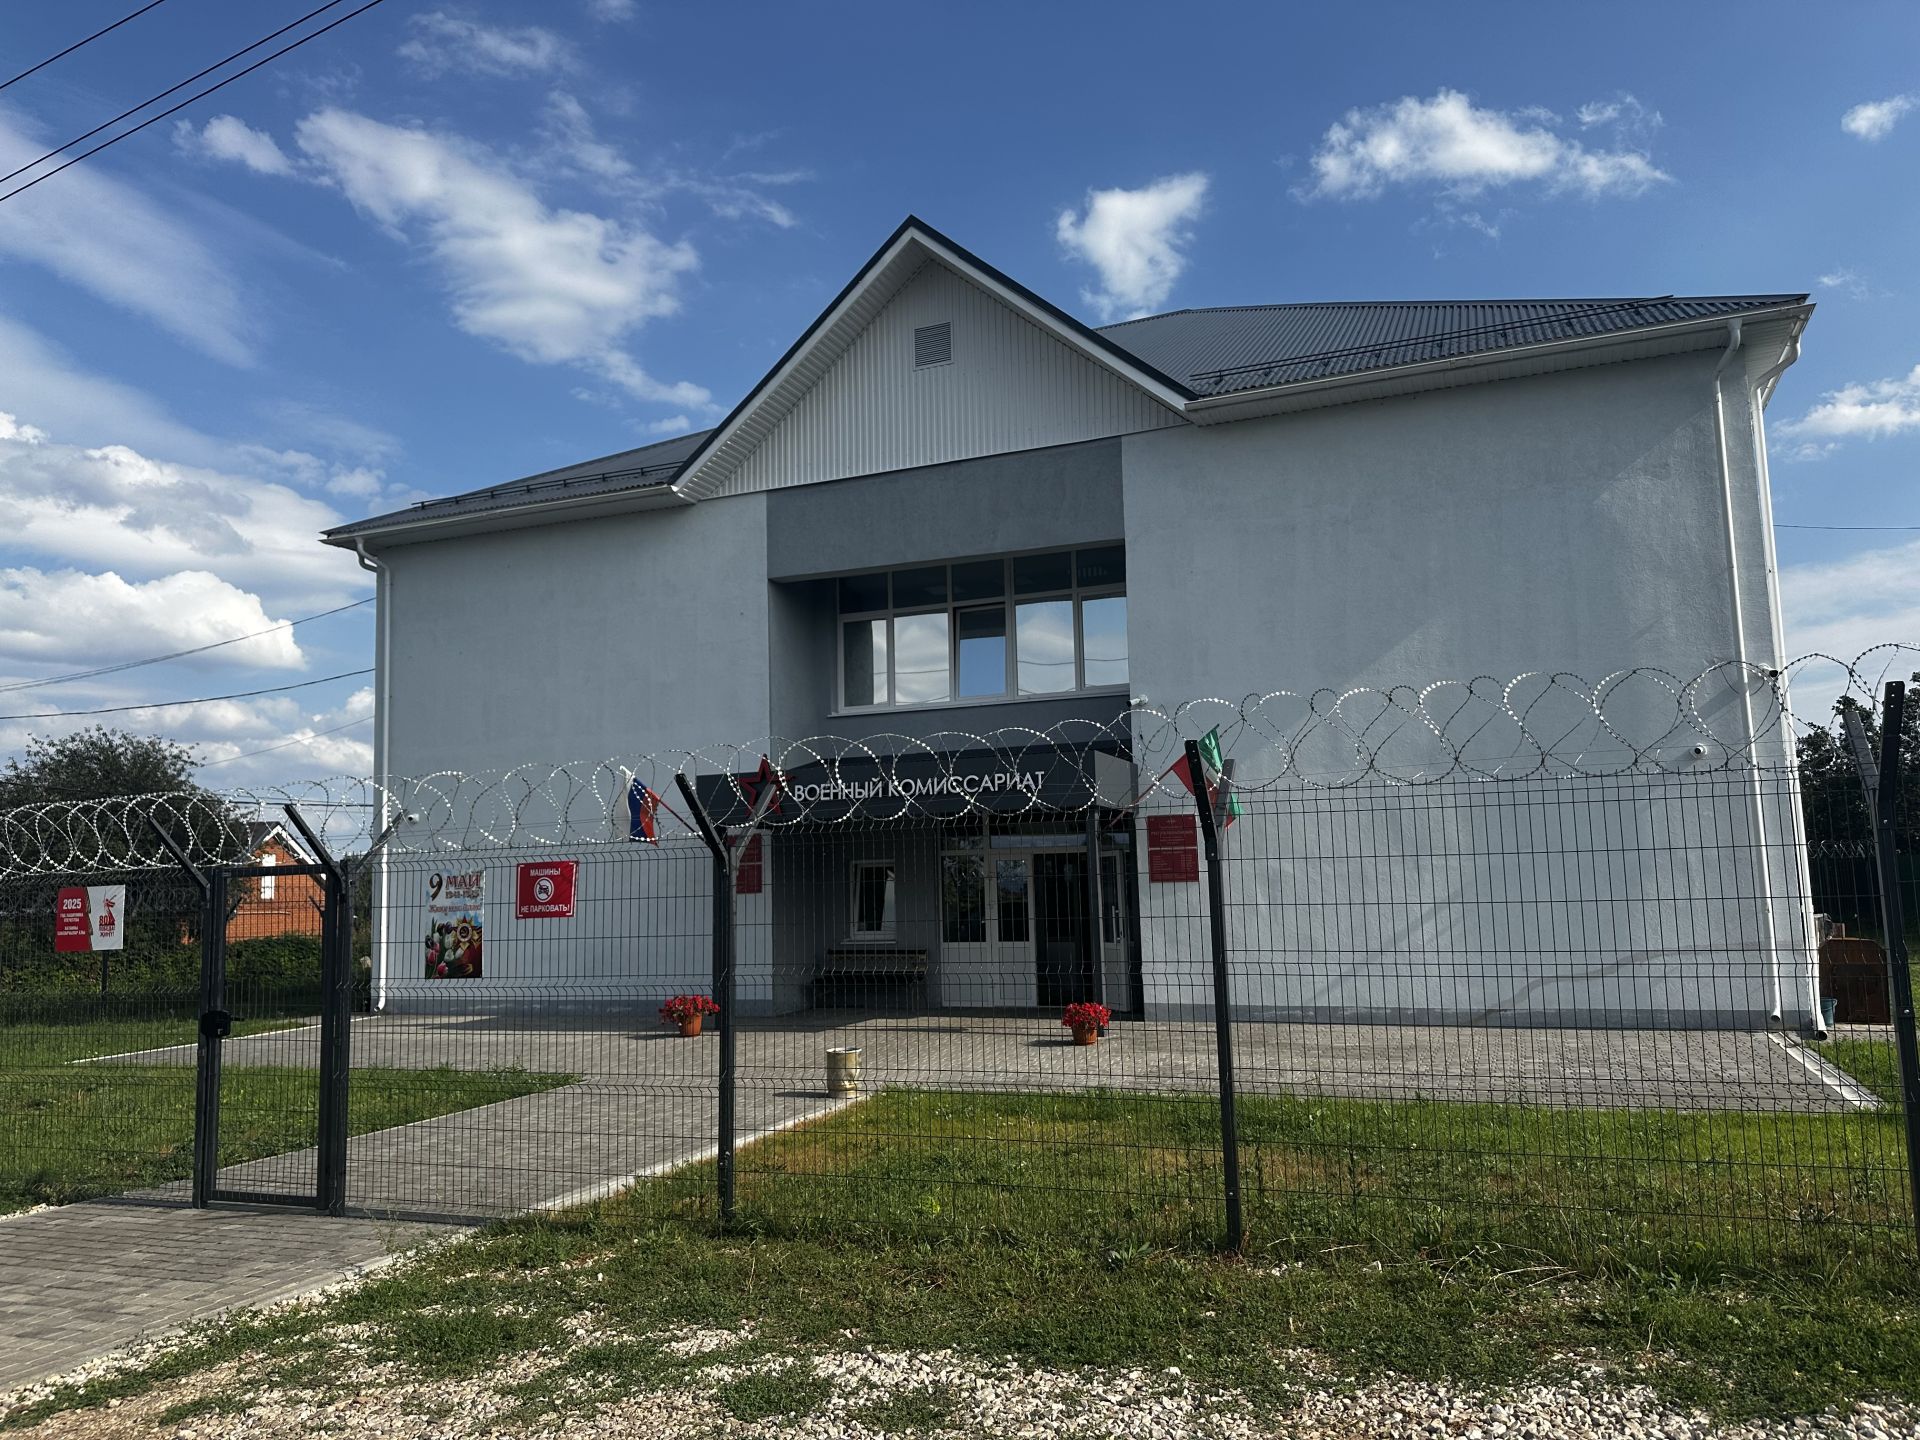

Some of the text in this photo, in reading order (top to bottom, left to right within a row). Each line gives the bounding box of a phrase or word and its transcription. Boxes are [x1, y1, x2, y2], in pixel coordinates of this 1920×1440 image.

[794, 771, 1045, 801] ВОЕННЫЙ КОМИССАРИАТ
[529, 867, 561, 877] МАШИНЫ
[429, 873, 443, 902] 9
[62, 898, 82, 910] 2025
[520, 903, 570, 914] НЕ ПАРКОВАТЬ!
